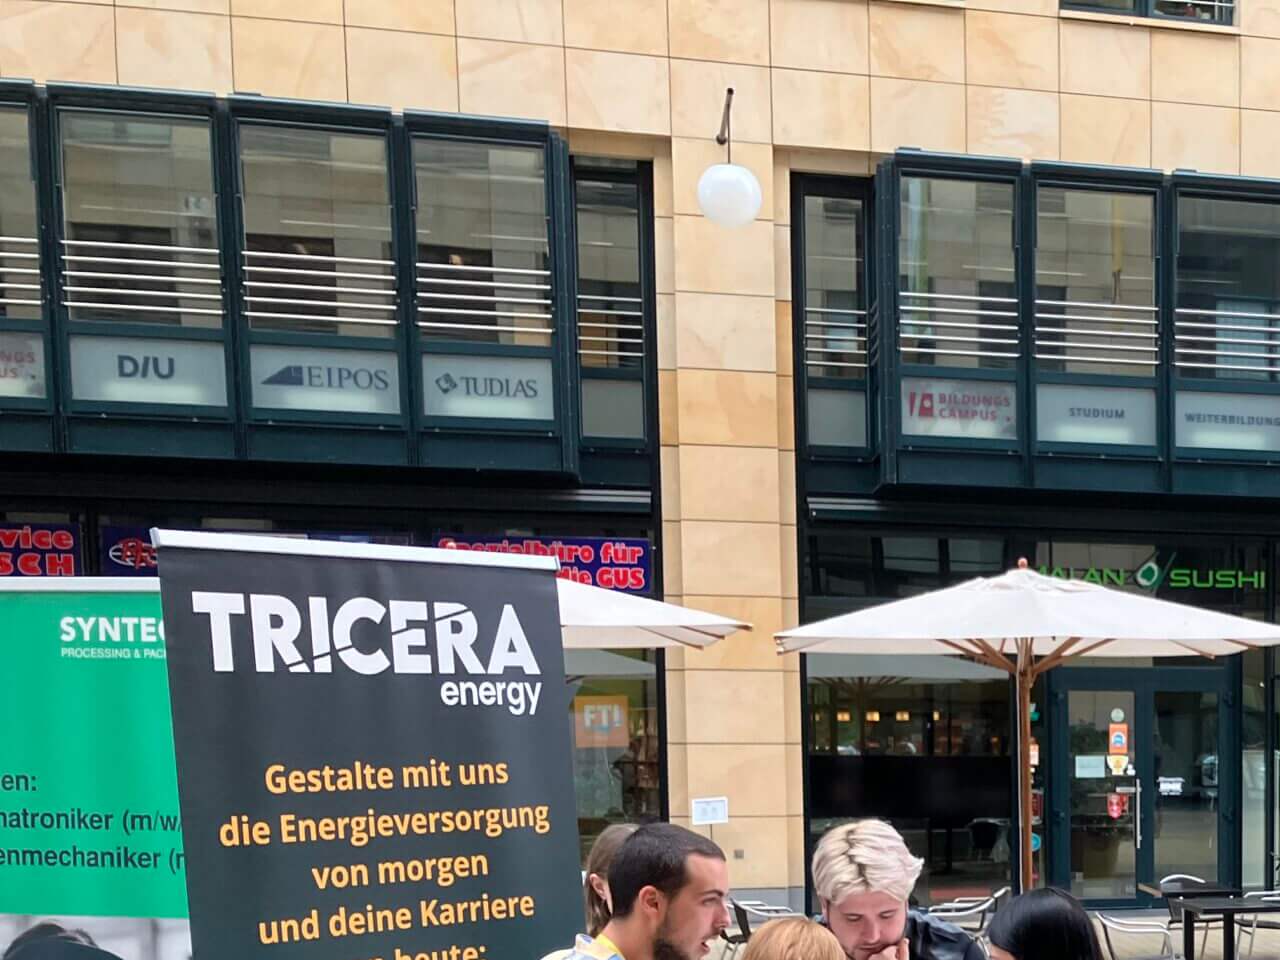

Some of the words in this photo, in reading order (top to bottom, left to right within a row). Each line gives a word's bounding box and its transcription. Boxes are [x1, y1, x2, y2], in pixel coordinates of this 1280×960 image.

[305, 366, 389, 390] EIPOS
[460, 376, 538, 398] TUDIAS
[938, 392, 1011, 408] BILDUNGS
[938, 407, 997, 421] CAMPUS
[1069, 407, 1125, 419] STUDIUM
[1184, 413, 1280, 427] WEITERBILDUNG
[600, 542, 644, 563] für
[596, 568, 645, 590] GUS
[1039, 565, 1125, 587] AAN
[1169, 569, 1266, 589] SUSHI
[191, 591, 541, 676] TRICERA
[61, 647, 131, 659] PROCESSING
[440, 679, 542, 716] energy
[265, 760, 394, 794] Gestalte
[402, 758, 452, 788] mit
[458, 761, 509, 786] uns
[218, 815, 271, 847] die
[280, 804, 550, 847] Energieversorgung
[311, 863, 369, 889] von
[378, 854, 489, 886] morgen
[258, 910, 320, 945] und
[328, 904, 412, 938] deine
[420, 893, 535, 928] Karriere
